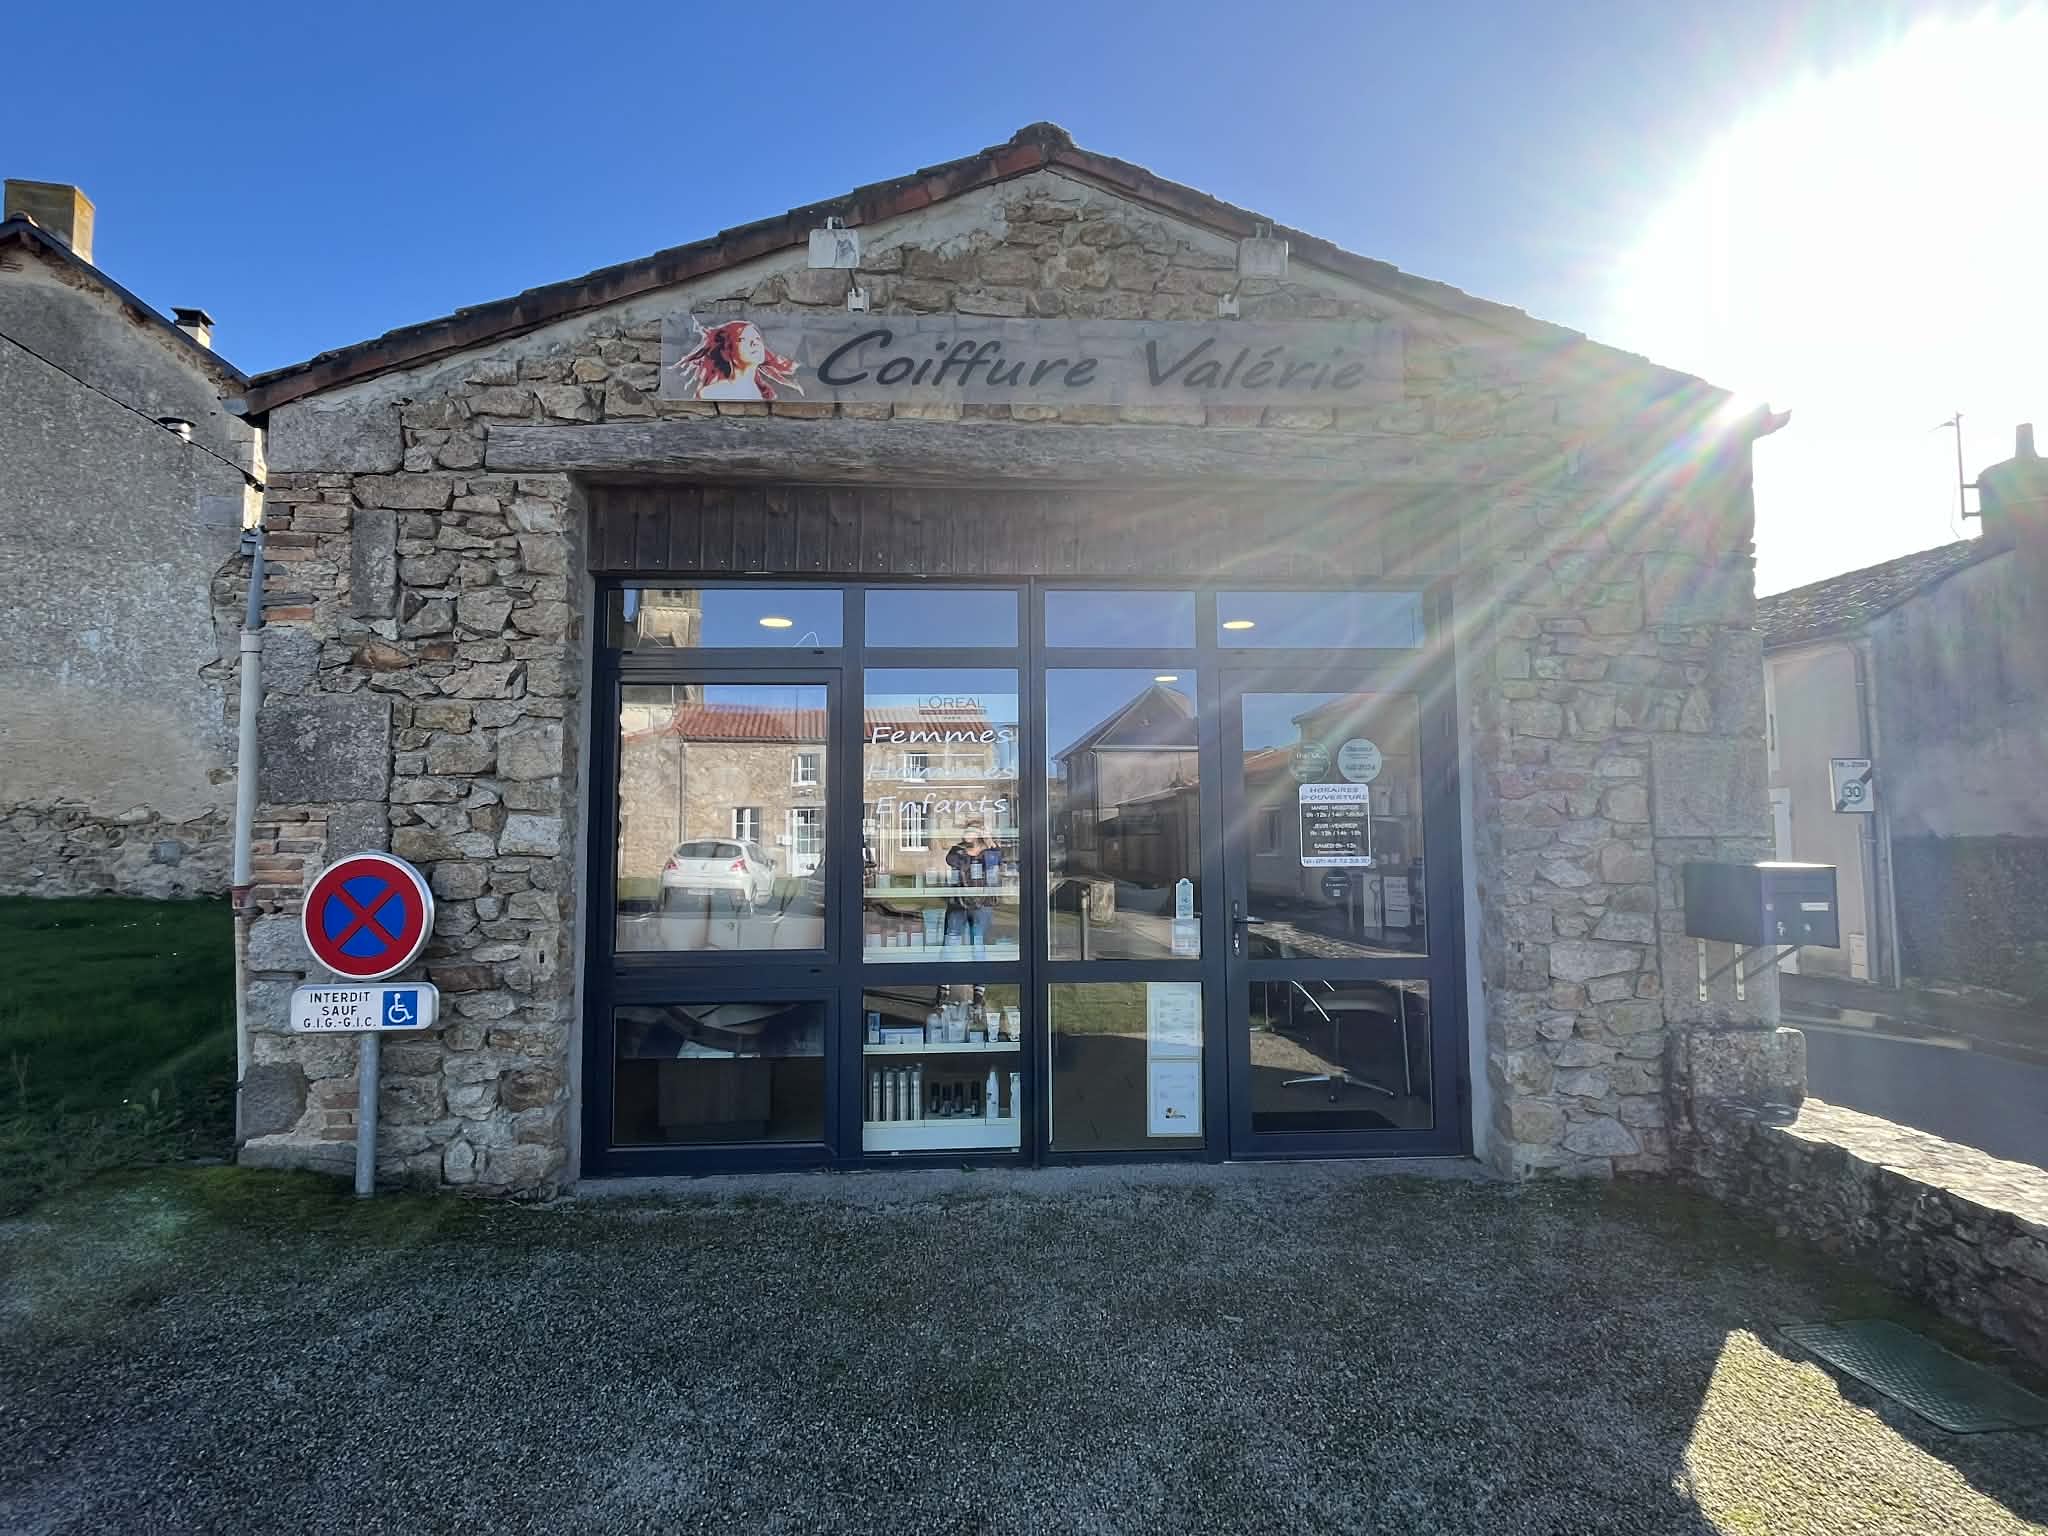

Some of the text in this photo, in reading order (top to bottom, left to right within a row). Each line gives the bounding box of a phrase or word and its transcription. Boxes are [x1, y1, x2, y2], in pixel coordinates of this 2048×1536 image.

[817, 329, 1365, 390] Coiffure Valérie
[871, 726, 1011, 745] Femmes
[1843, 786, 1862, 798] 30
[876, 793, 1008, 815] Enfants
[310, 992, 371, 1003] INTERDIT
[321, 1005, 358, 1016] SAUF
